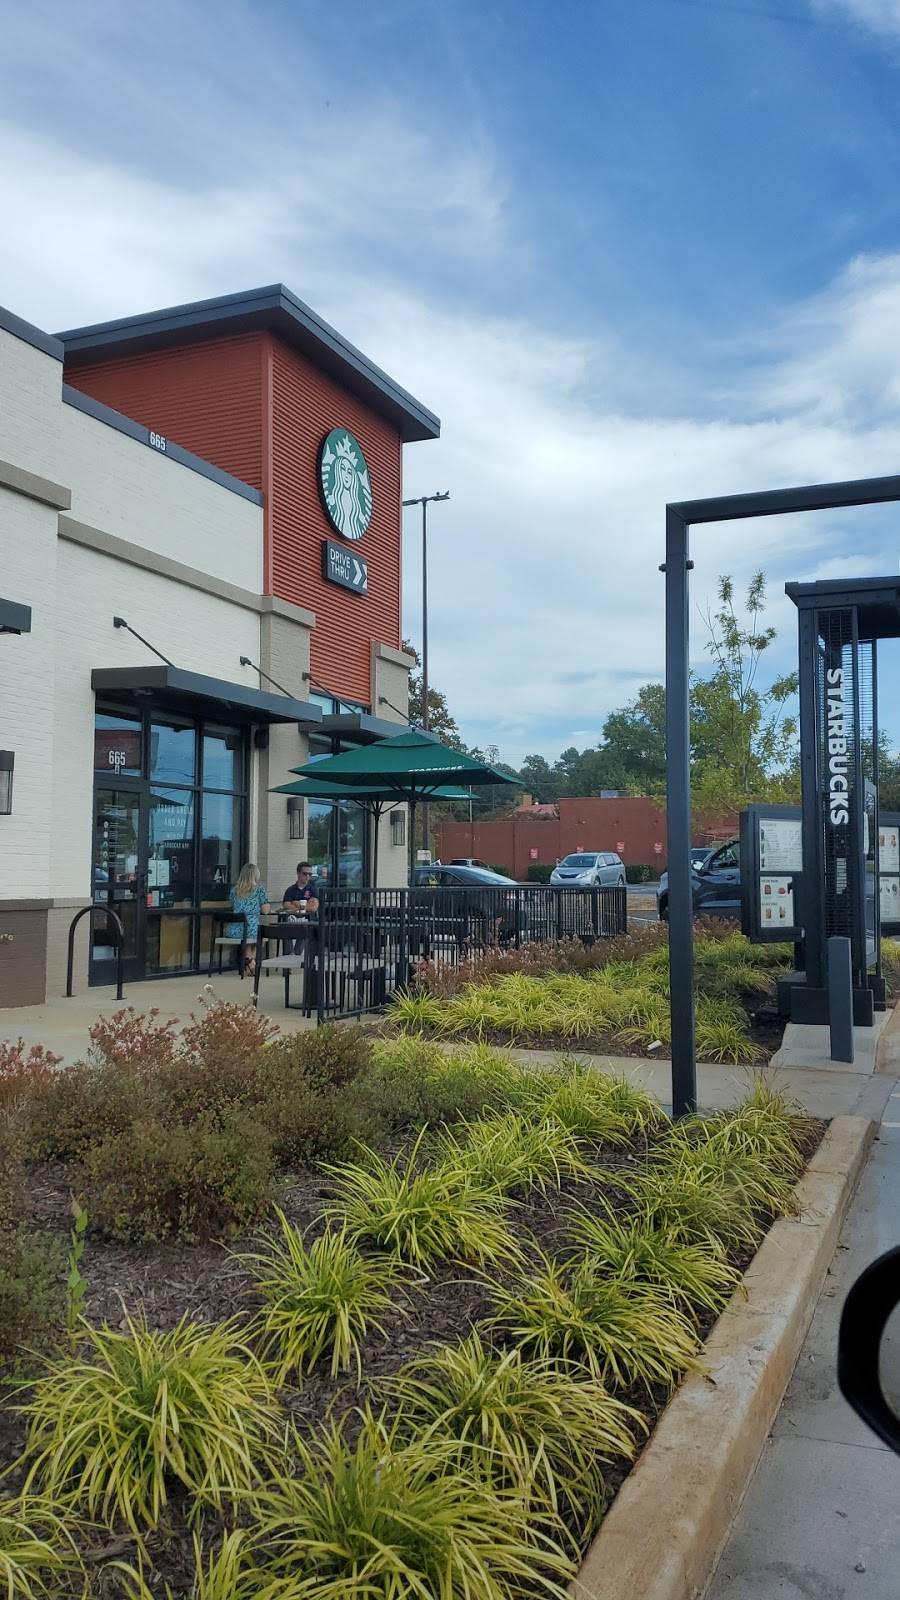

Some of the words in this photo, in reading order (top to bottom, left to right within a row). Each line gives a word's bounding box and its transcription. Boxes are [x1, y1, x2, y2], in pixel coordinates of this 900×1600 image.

[150, 431, 166, 451] 665
[330, 547, 351, 569] DRIVE
[330, 560, 350, 581] THRU
[826, 668, 849, 826] STARBUCKS
[108, 750, 126, 766] 665
